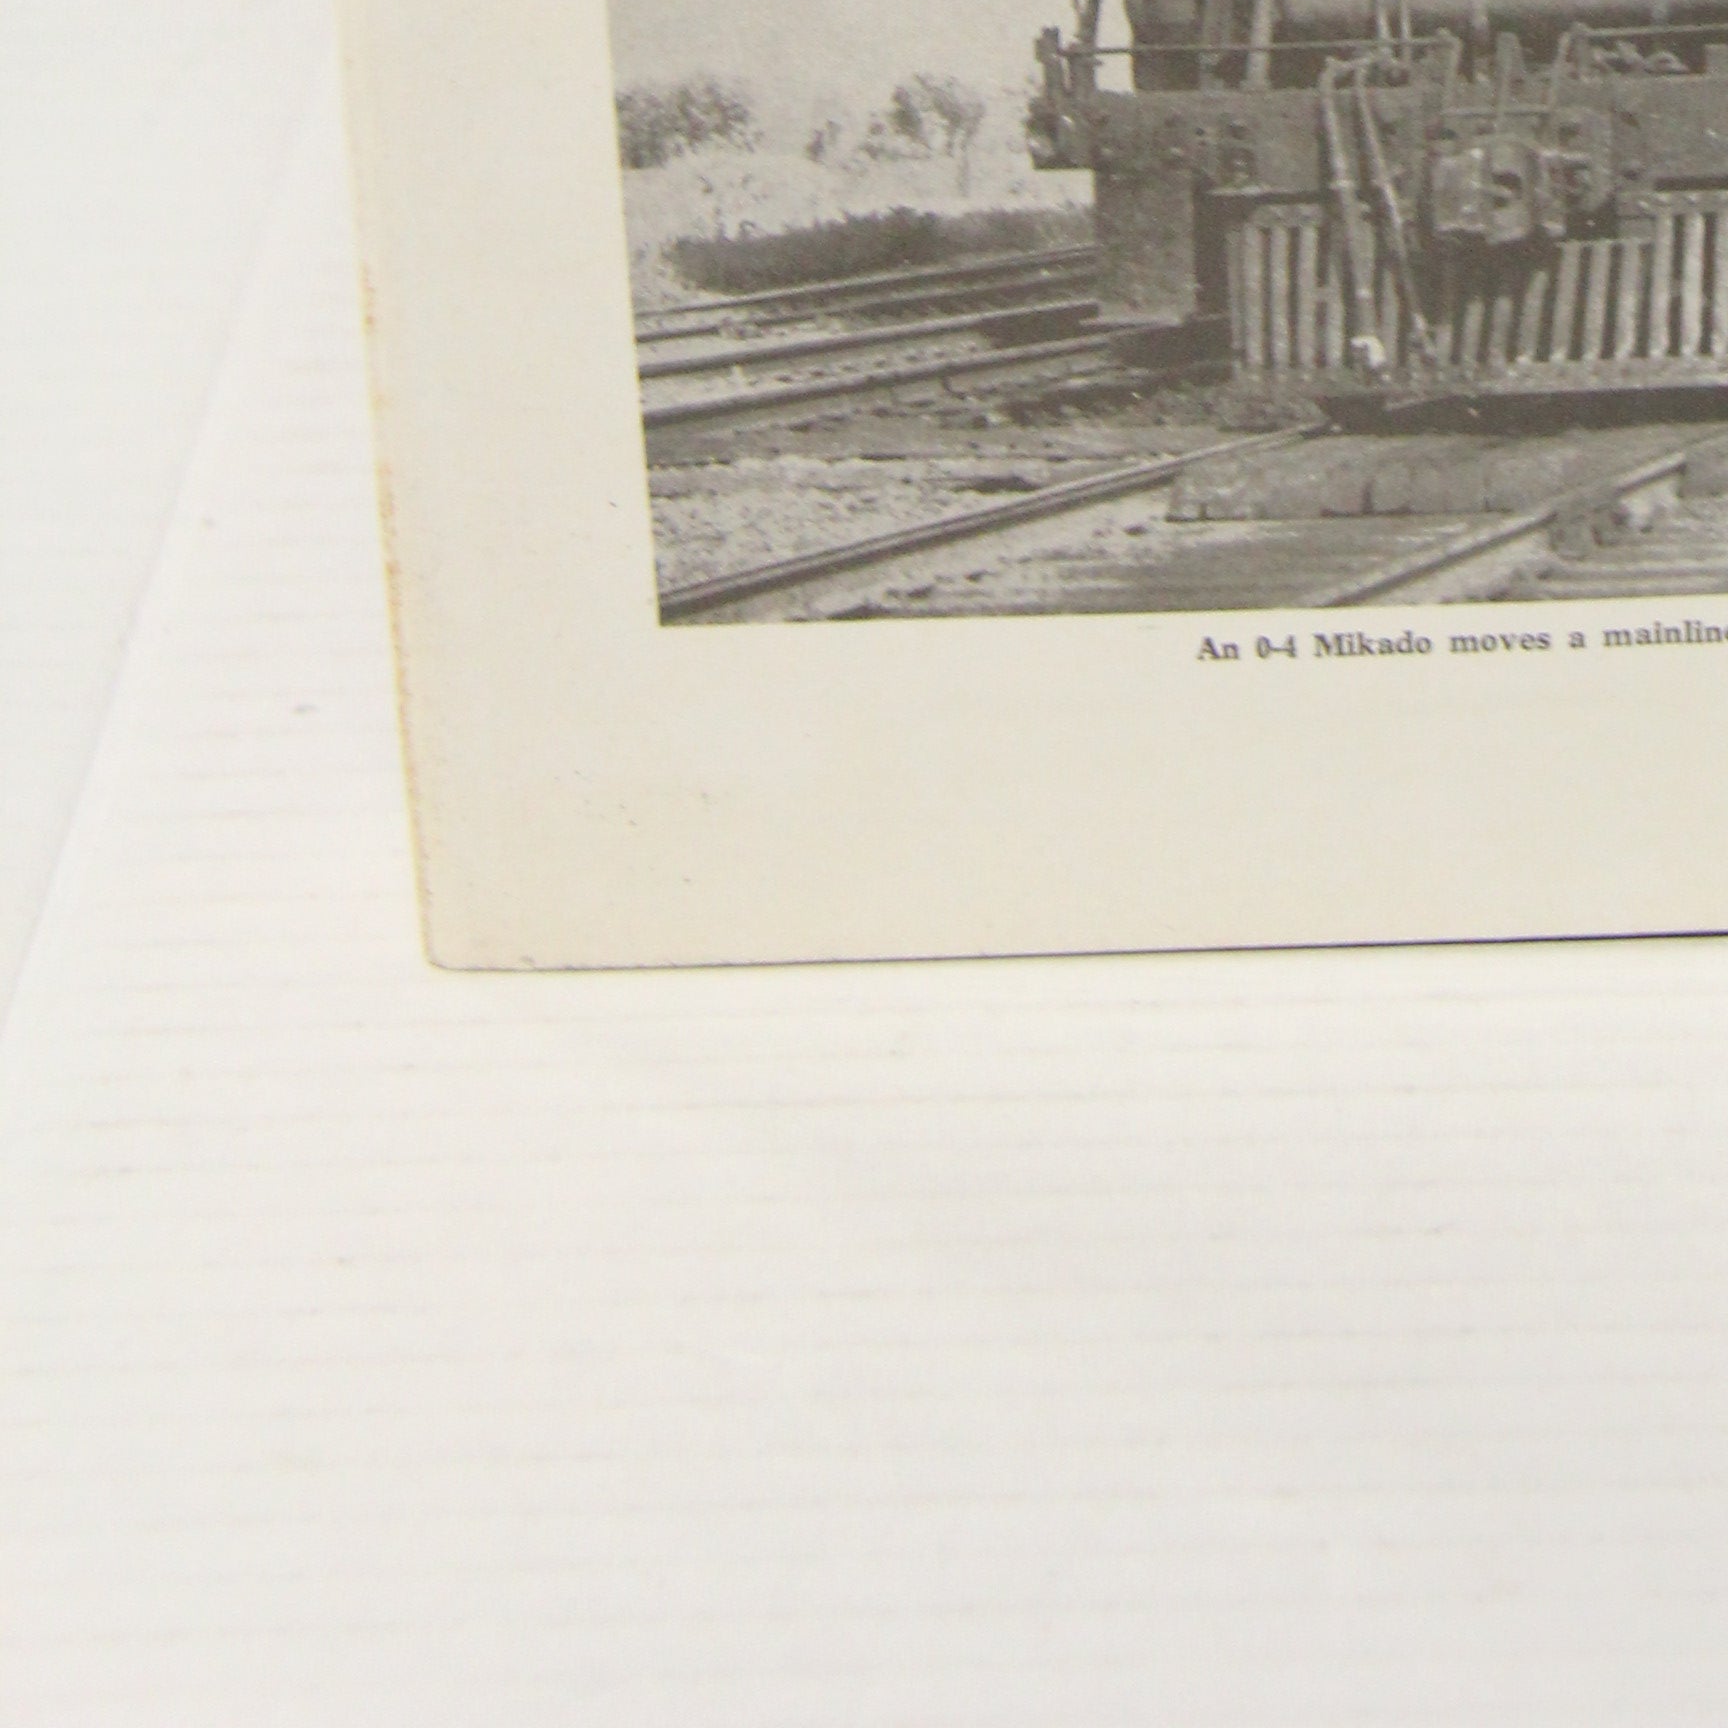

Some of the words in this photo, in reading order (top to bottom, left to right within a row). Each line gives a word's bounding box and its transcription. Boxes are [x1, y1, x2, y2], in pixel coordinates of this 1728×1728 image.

[1196, 636, 1240, 661] An
[1313, 629, 1433, 659] Mikado
[1449, 631, 1552, 654] moves
[1568, 631, 1586, 650] a
